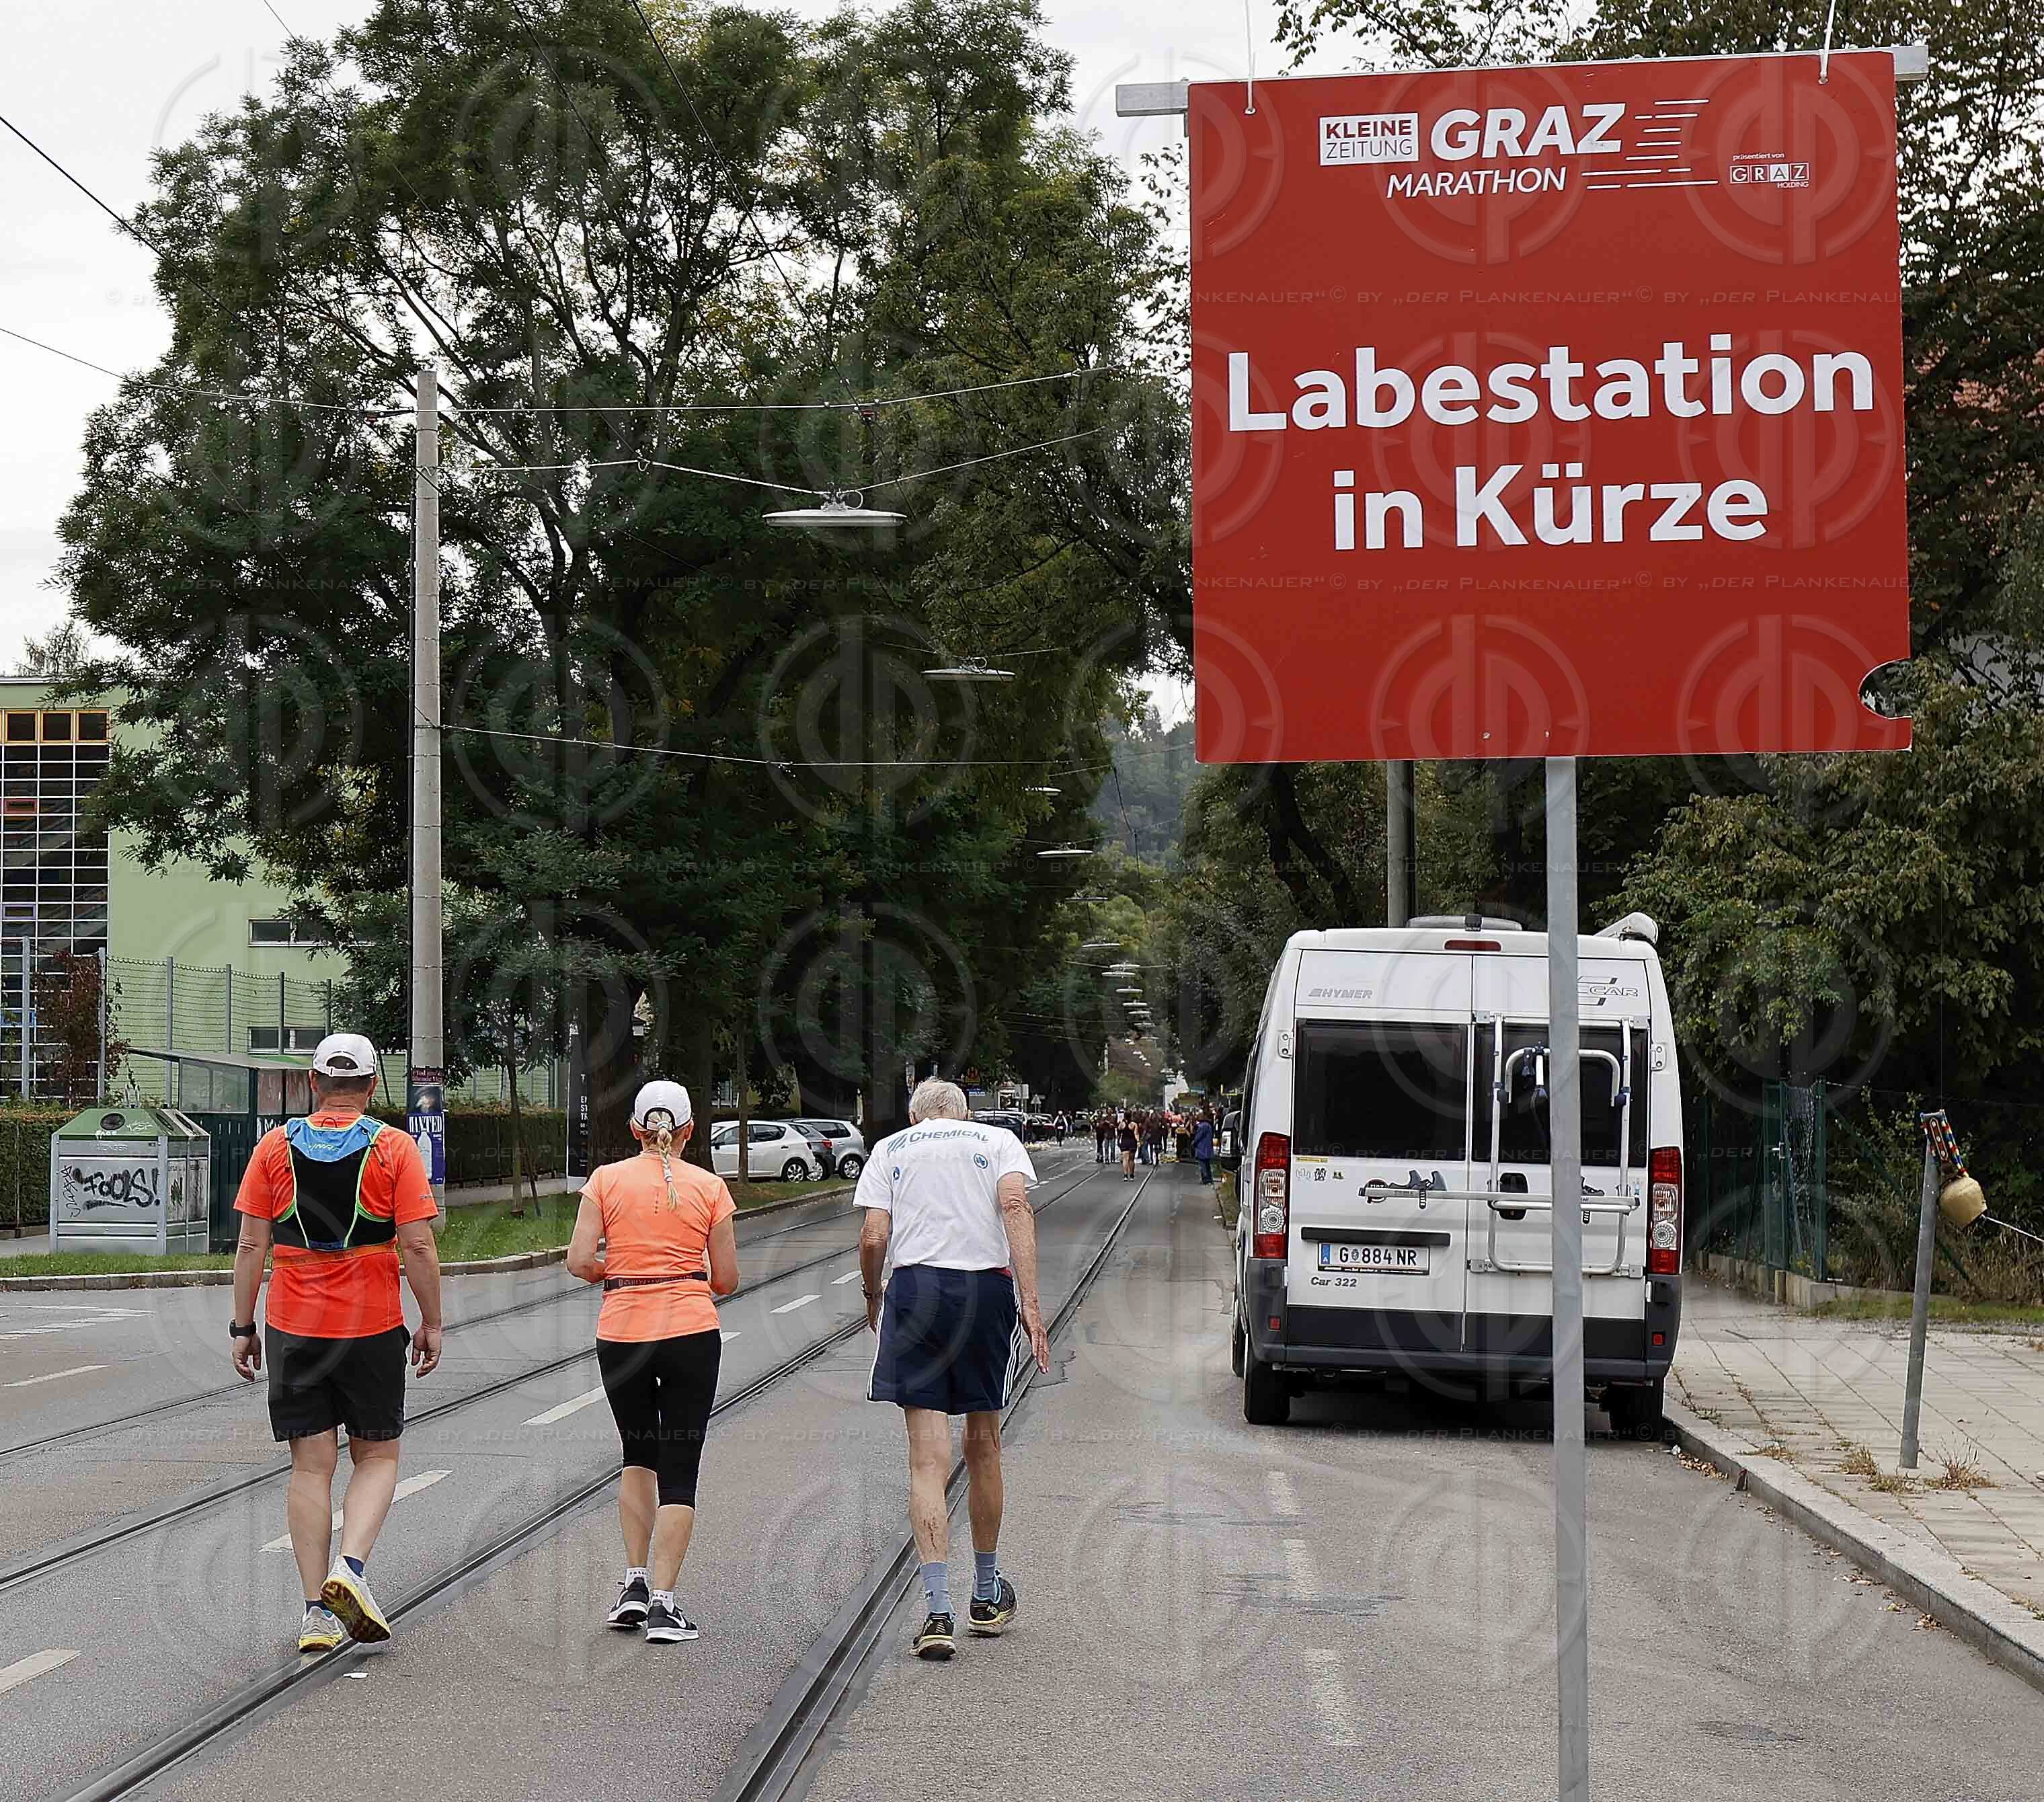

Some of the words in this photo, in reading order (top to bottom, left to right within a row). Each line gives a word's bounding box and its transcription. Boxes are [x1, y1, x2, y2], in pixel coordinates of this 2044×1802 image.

[1326, 120, 1412, 139] KLEINE
[1430, 103, 1626, 161] GRAZ
[1326, 139, 1412, 159] ZEITUNG
[1387, 166, 1567, 198] MARATHON
[1732, 165, 1806, 182] GRAZ
[1228, 334, 1873, 432] Labestation
[1333, 470, 1423, 550] in
[1456, 462, 1768, 547] Kürze
[409, 1115, 442, 1133] WANTED
[909, 1129, 989, 1142] CHEMICAL
[1339, 1247, 1349, 1263] G
[1362, 1247, 1392, 1265] 884
[1397, 1249, 1417, 1266] NR
[1310, 1276, 1331, 1286] Car
[1335, 1278, 1357, 1288] 322
